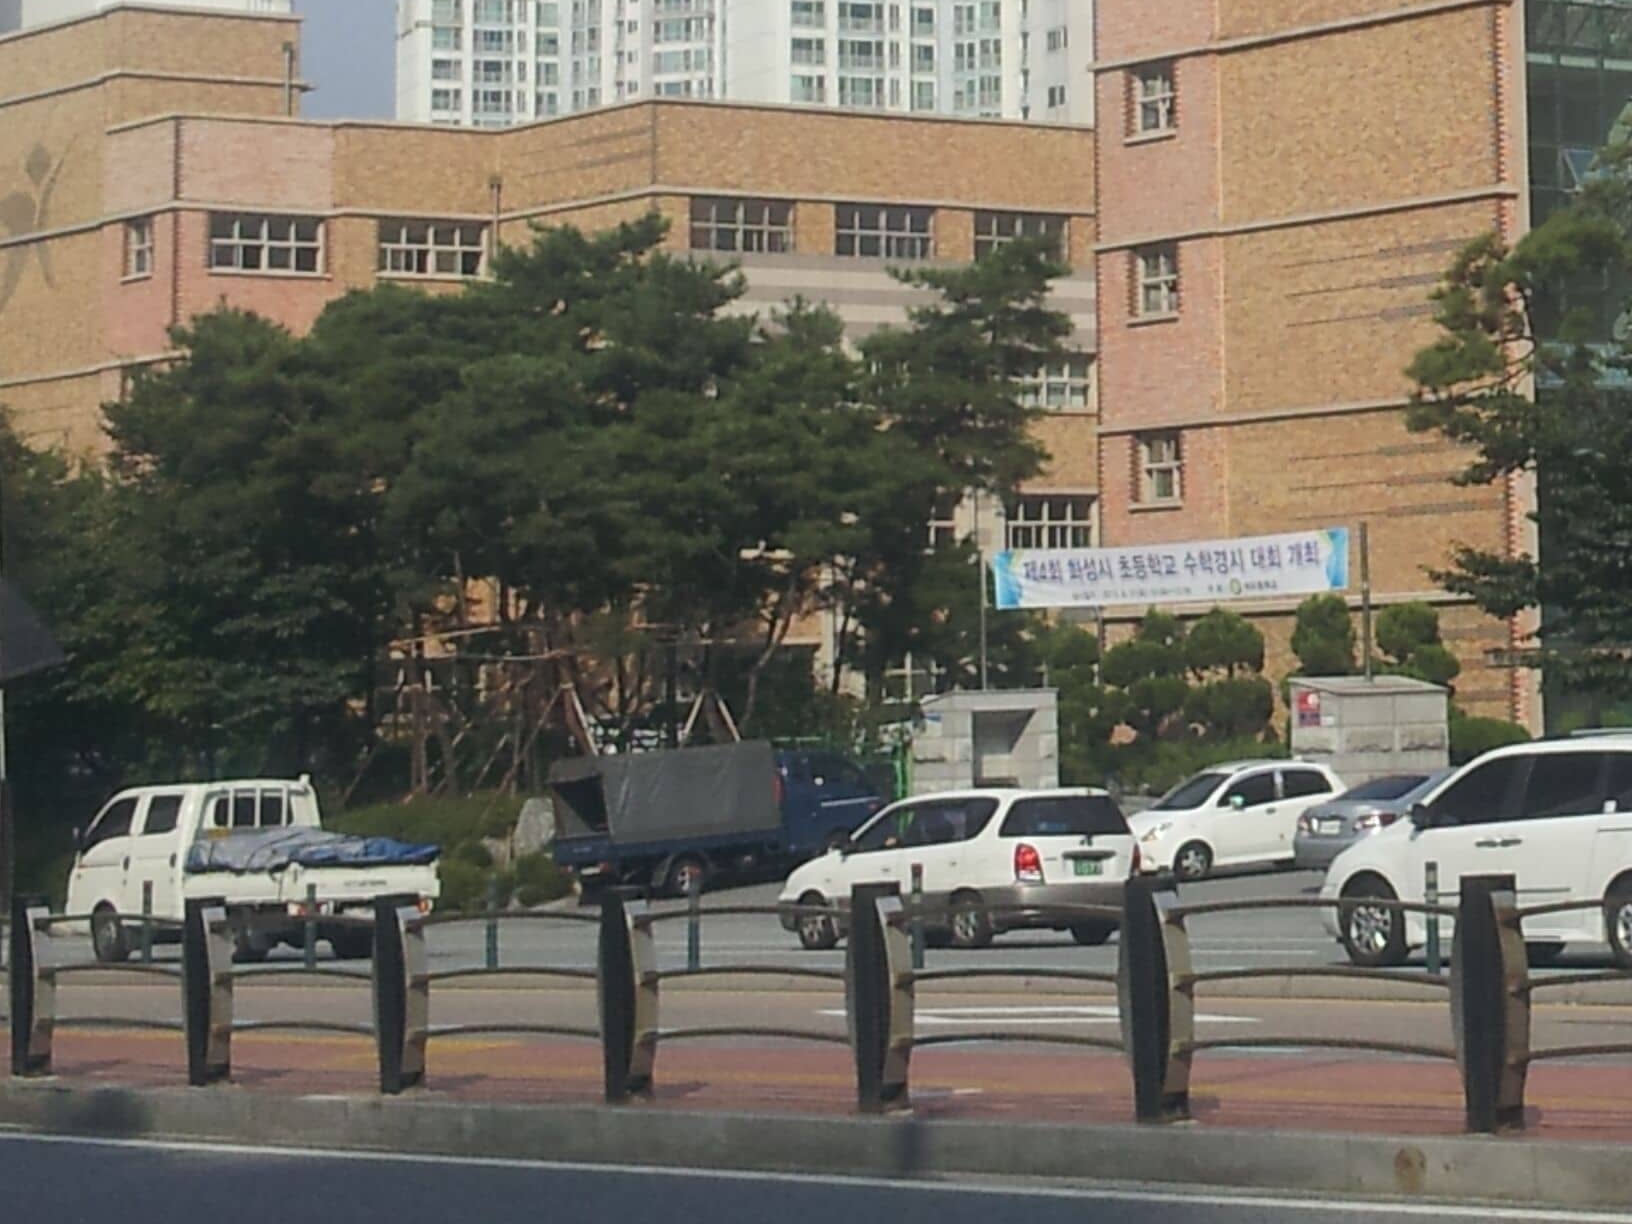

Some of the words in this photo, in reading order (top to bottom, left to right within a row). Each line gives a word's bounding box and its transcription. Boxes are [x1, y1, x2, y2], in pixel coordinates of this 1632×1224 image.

[1068, 555, 1113, 582] 화성시
[1119, 552, 1177, 580] 초등학교
[1184, 547, 1244, 575] 수학경시
[1251, 544, 1281, 569] 대회
[1288, 540, 1320, 566] 개최
